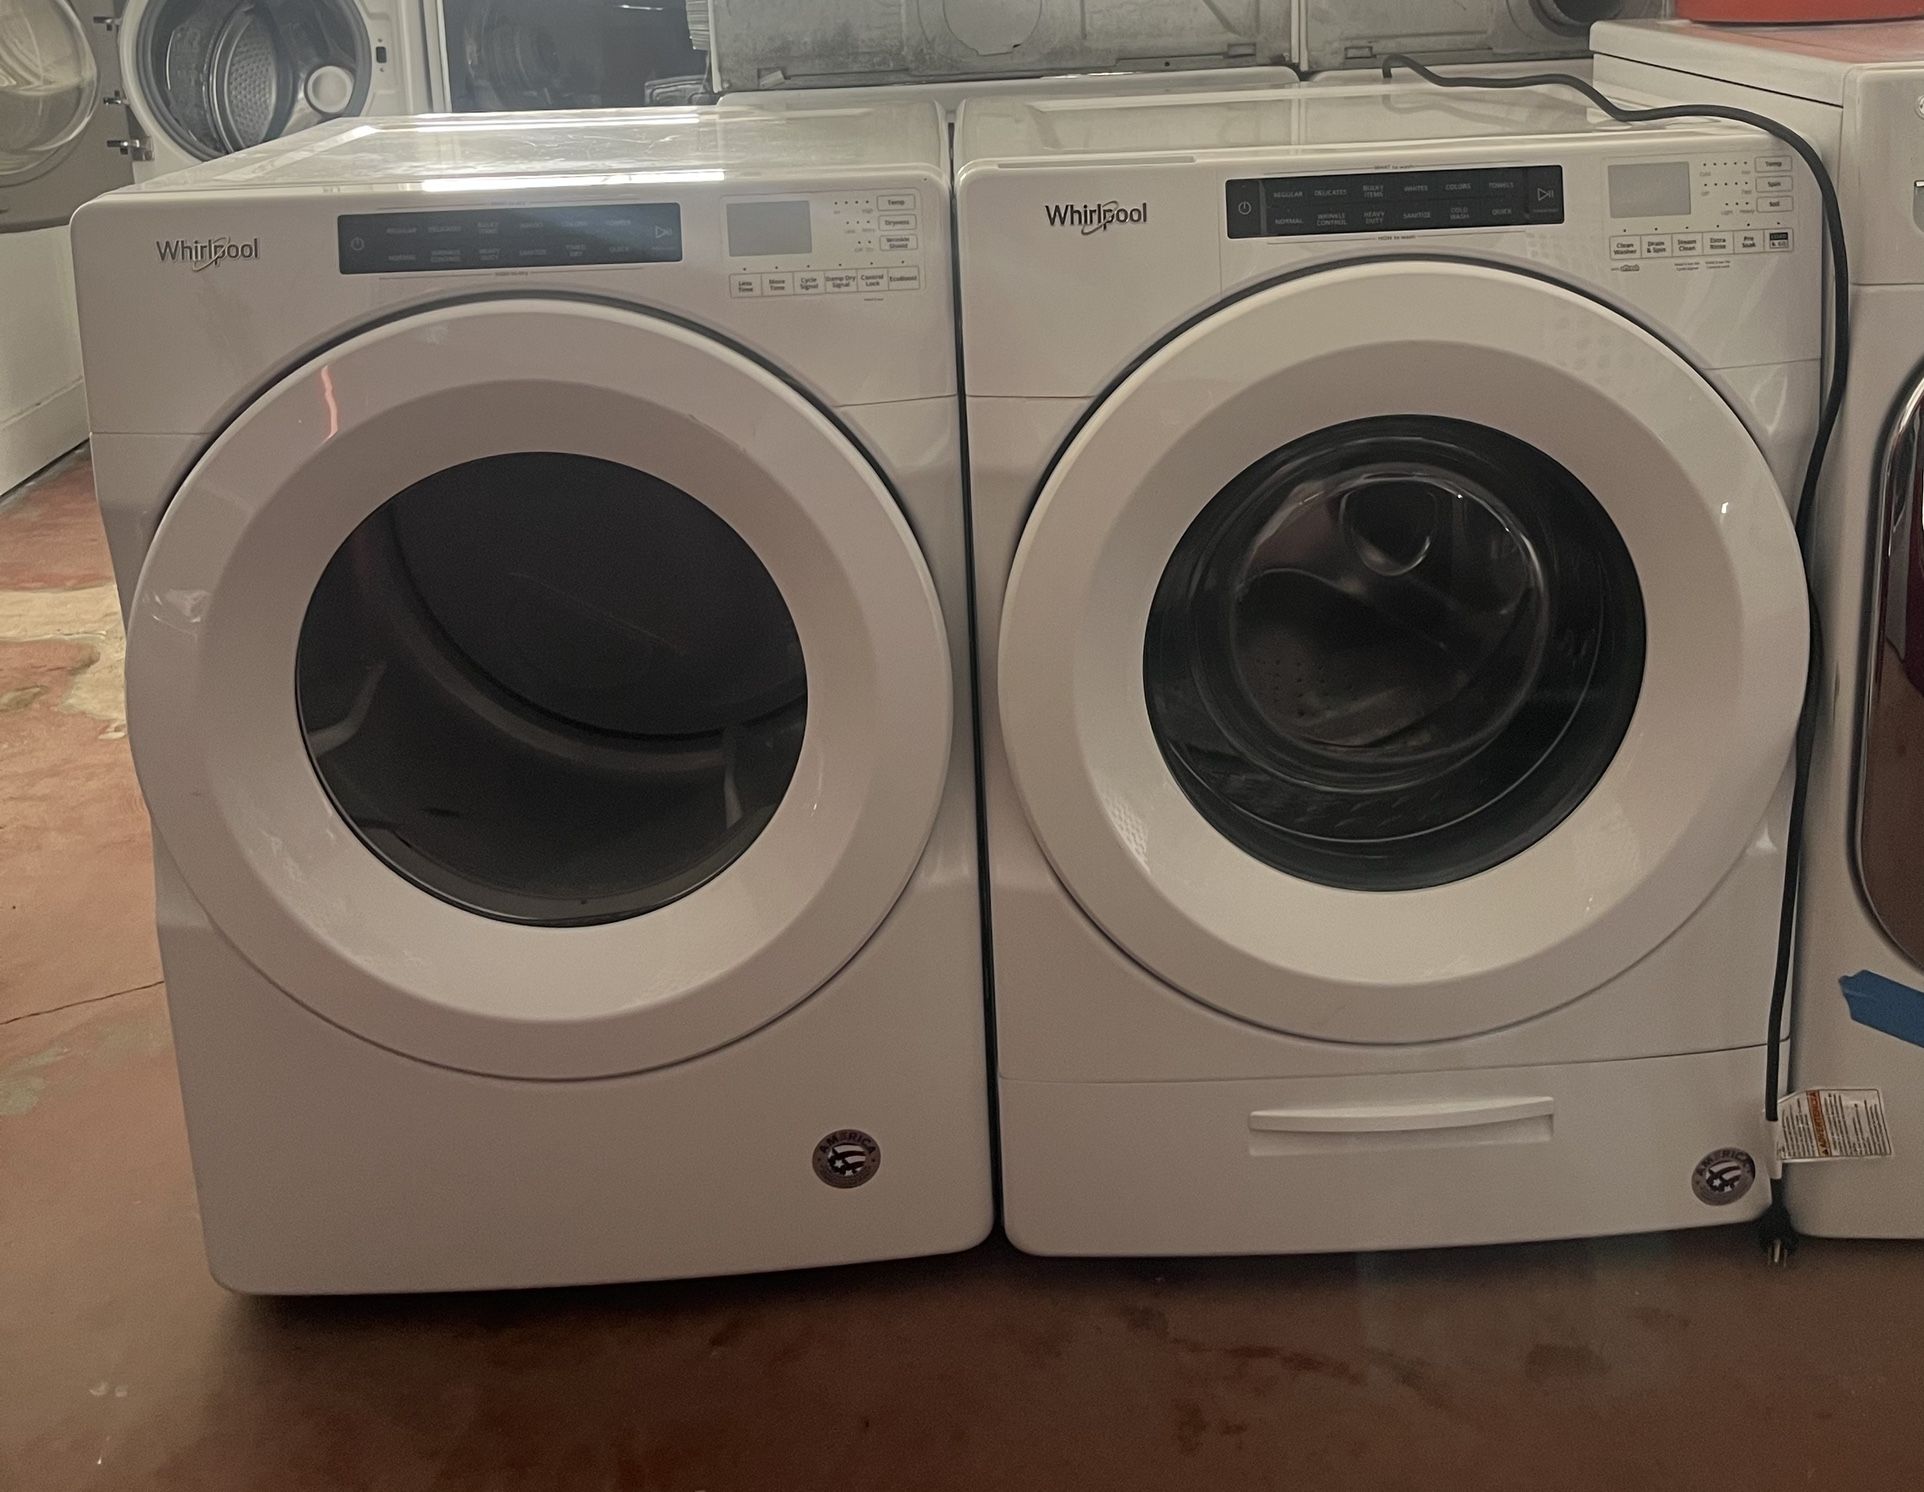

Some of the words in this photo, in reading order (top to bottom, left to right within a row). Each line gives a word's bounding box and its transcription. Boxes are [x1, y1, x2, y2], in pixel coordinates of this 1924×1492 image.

[1314, 189, 1347, 197] DELICATES
[1045, 200, 1147, 235] Whirlpool
[156, 237, 259, 271] Whirlpool
[801, 276, 817, 284] Cycle
